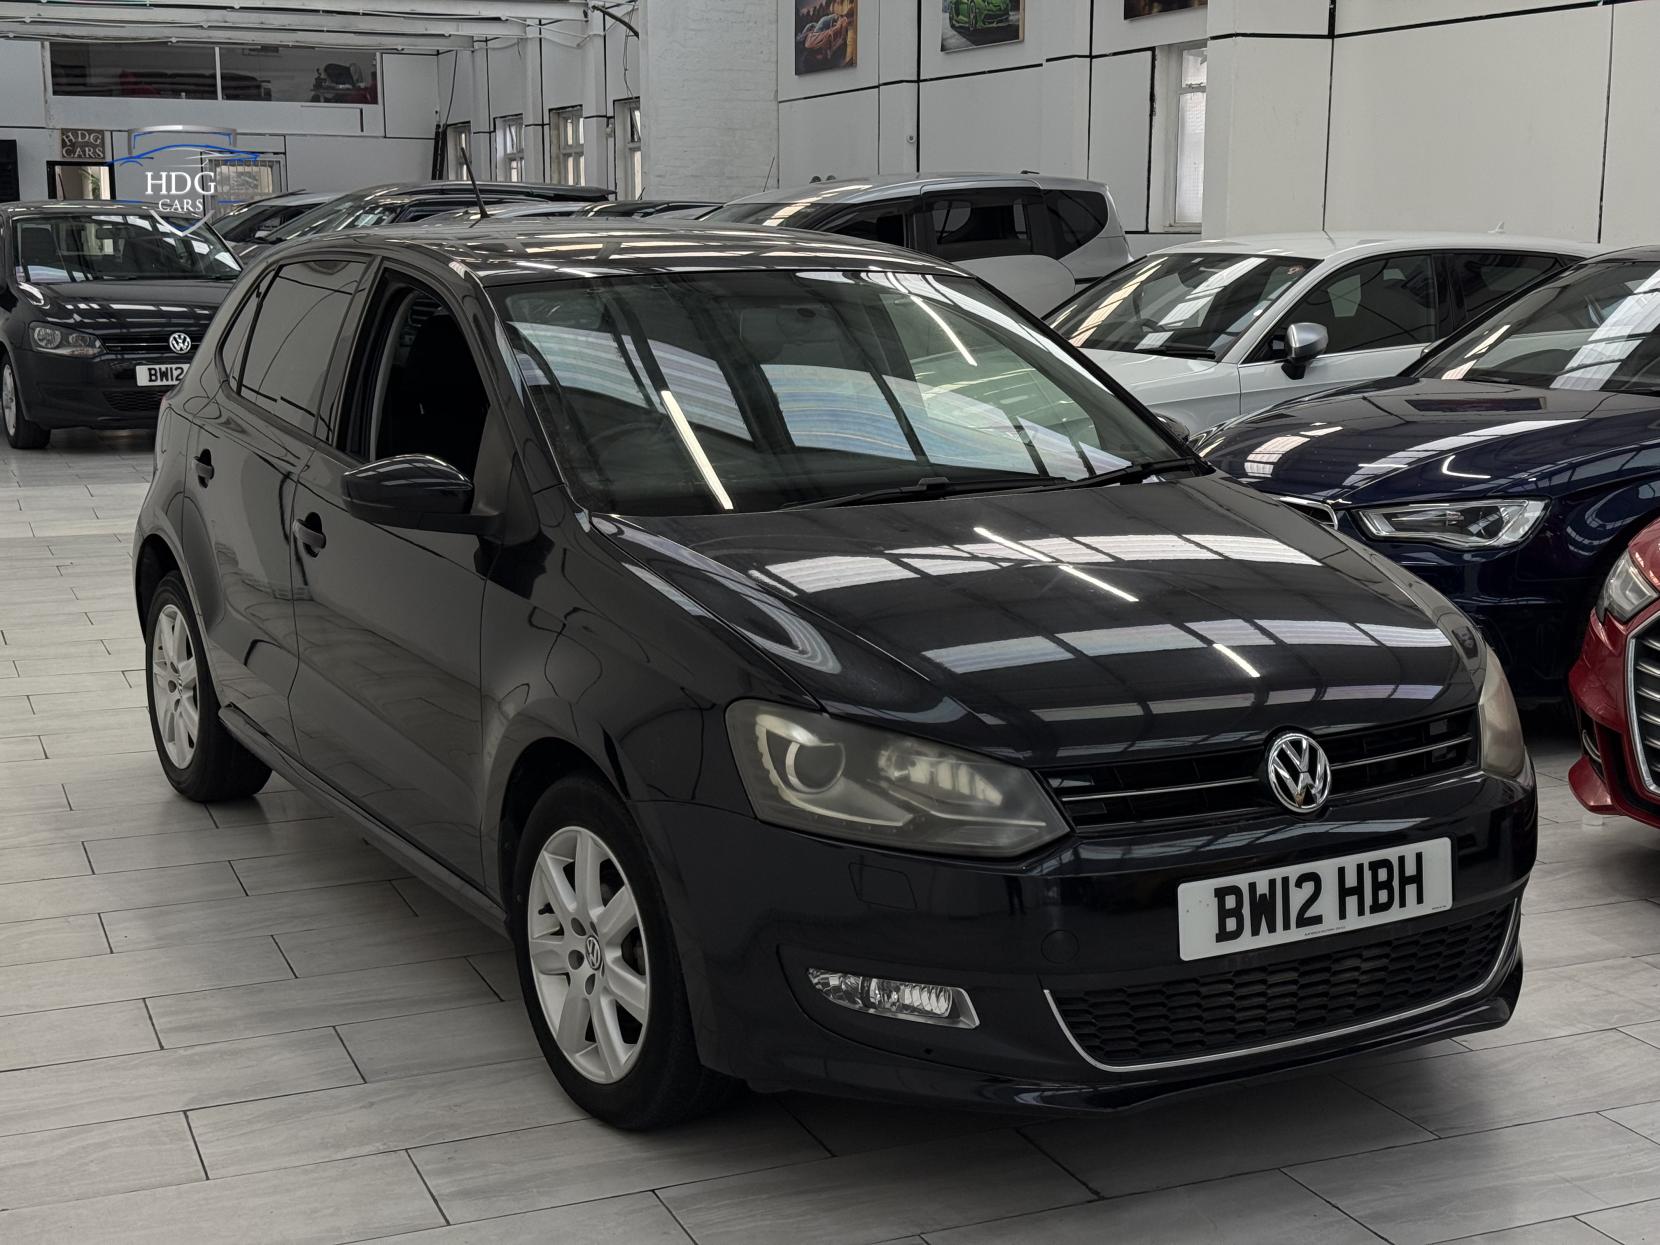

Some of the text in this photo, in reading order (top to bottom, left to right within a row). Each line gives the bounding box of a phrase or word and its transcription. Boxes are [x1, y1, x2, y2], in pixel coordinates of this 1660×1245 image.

[63, 131, 102, 146] HDG
[62, 147, 104, 159] CARS
[147, 366, 184, 383] BW12
[1213, 851, 1424, 943] BW12 HBH
